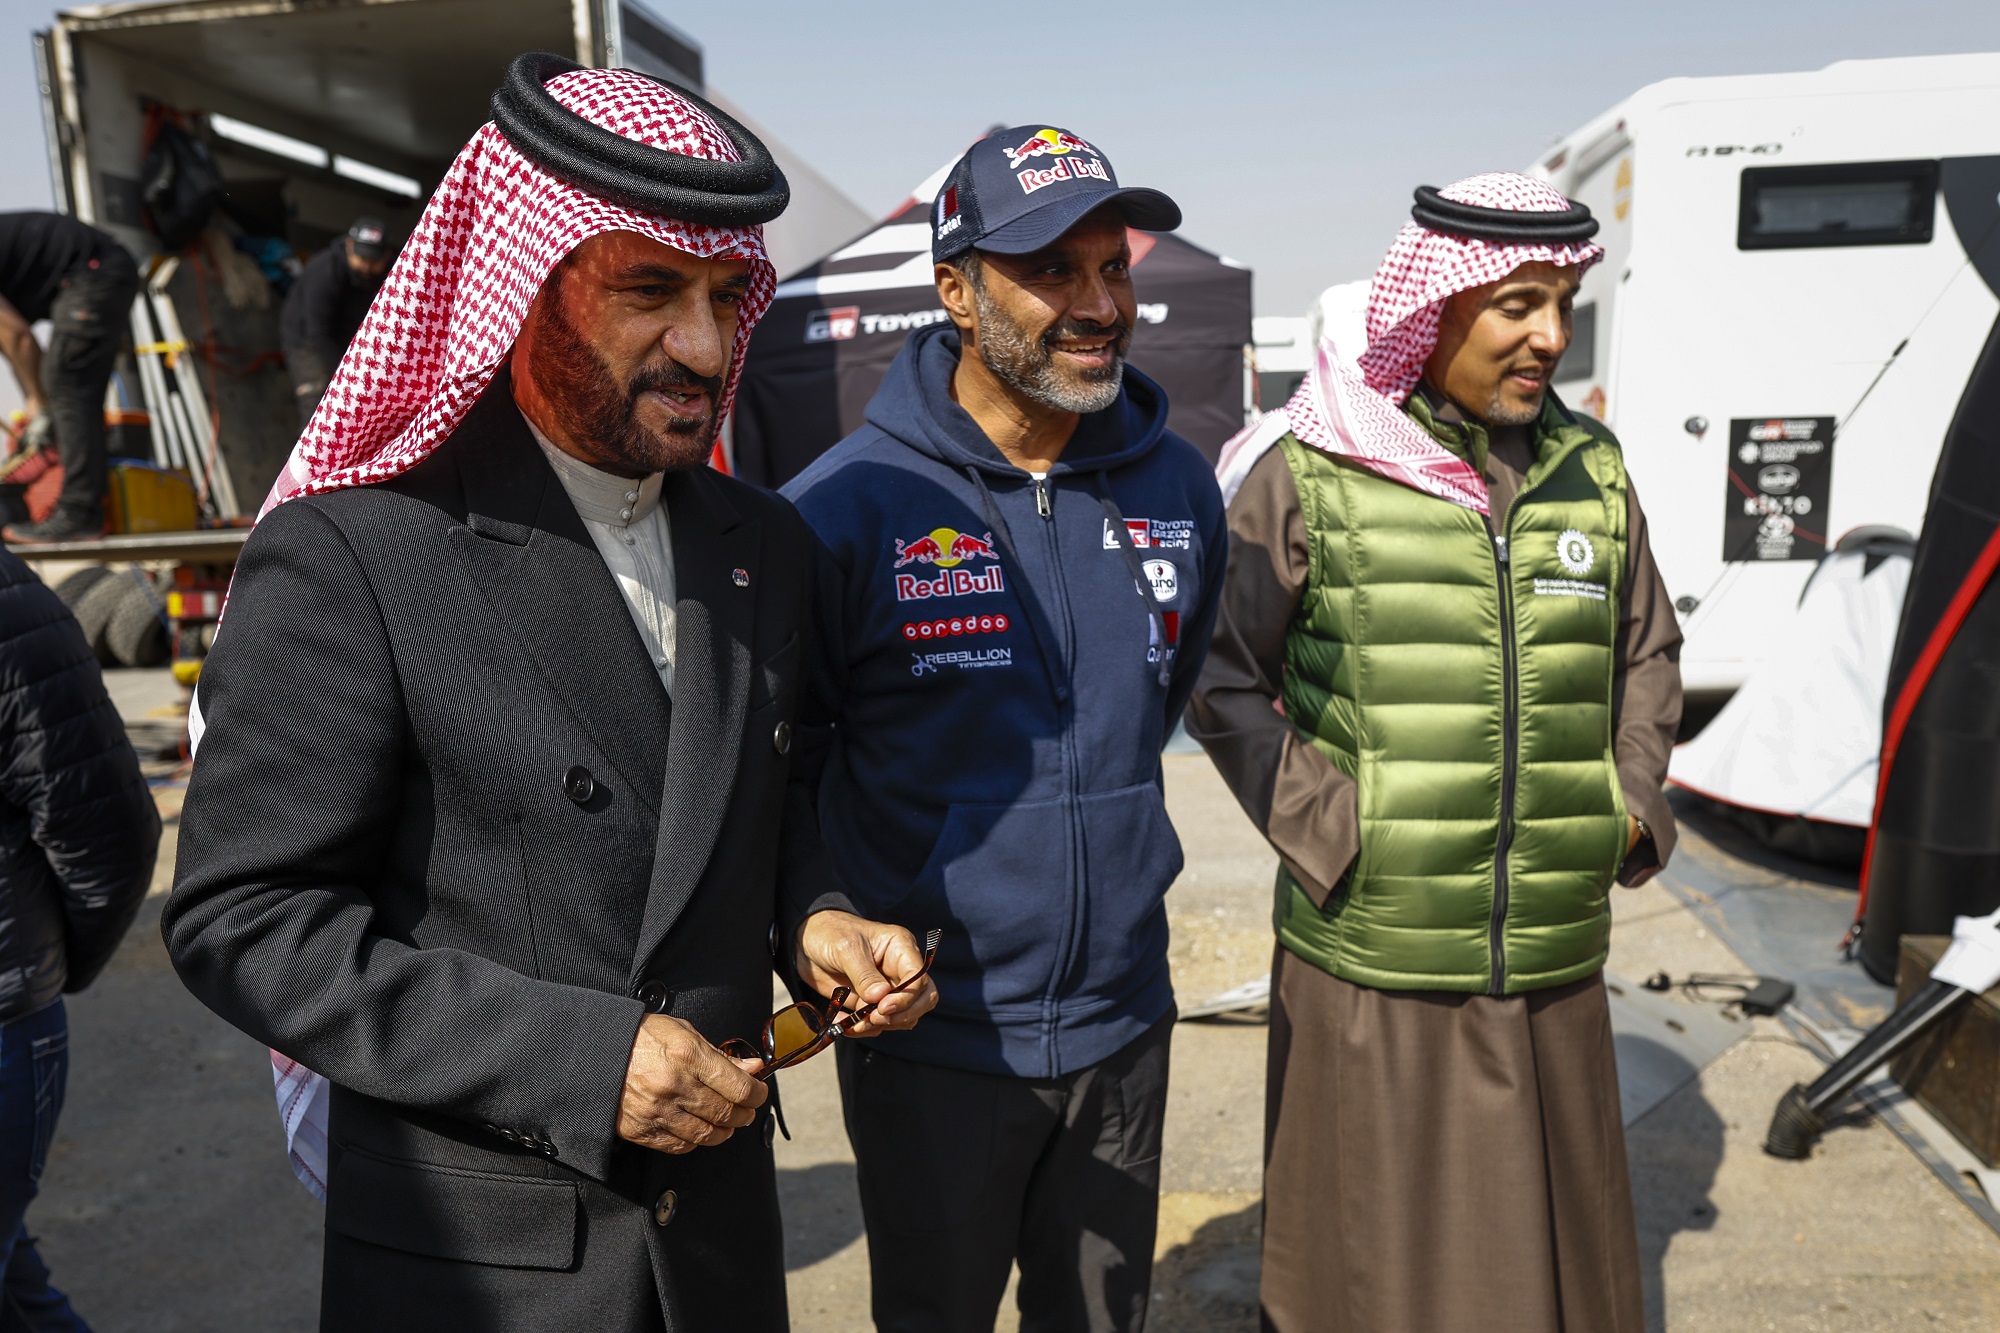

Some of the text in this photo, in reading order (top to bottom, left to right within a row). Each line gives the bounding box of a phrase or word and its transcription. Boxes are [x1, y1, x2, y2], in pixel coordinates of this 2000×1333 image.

[1018, 157, 1110, 194] Red Bull
[806, 309, 950, 341] GR TOYOT
[1151, 520, 1194, 530] TOYOTA
[1151, 529, 1190, 539] GAZOO
[1152, 538, 1189, 550] Racing
[895, 565, 1005, 601] Red Bull
[1148, 574, 1176, 588] urol
[904, 615, 1007, 638] ooredoo
[925, 648, 1012, 664] REBELLION
